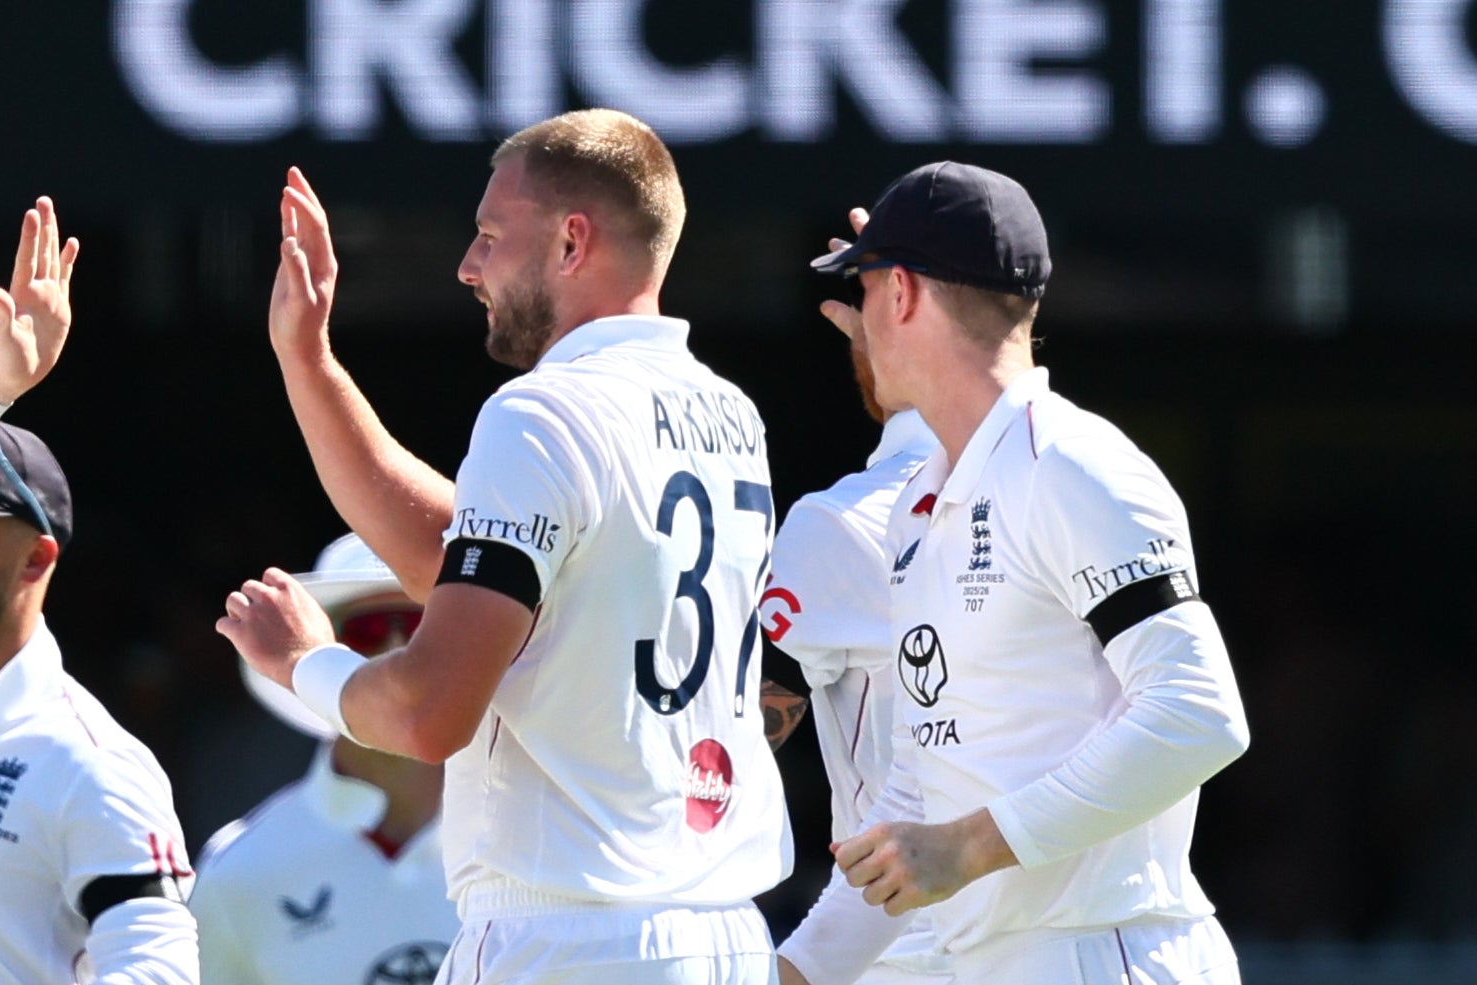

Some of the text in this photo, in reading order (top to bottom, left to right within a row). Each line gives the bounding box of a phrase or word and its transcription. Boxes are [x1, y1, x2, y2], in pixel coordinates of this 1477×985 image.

[634, 470, 773, 718] 37
[1072, 538, 1175, 601] Tyrrell
[758, 572, 802, 642] G
[965, 598, 985, 612] 707
[911, 718, 961, 748] YOTA
